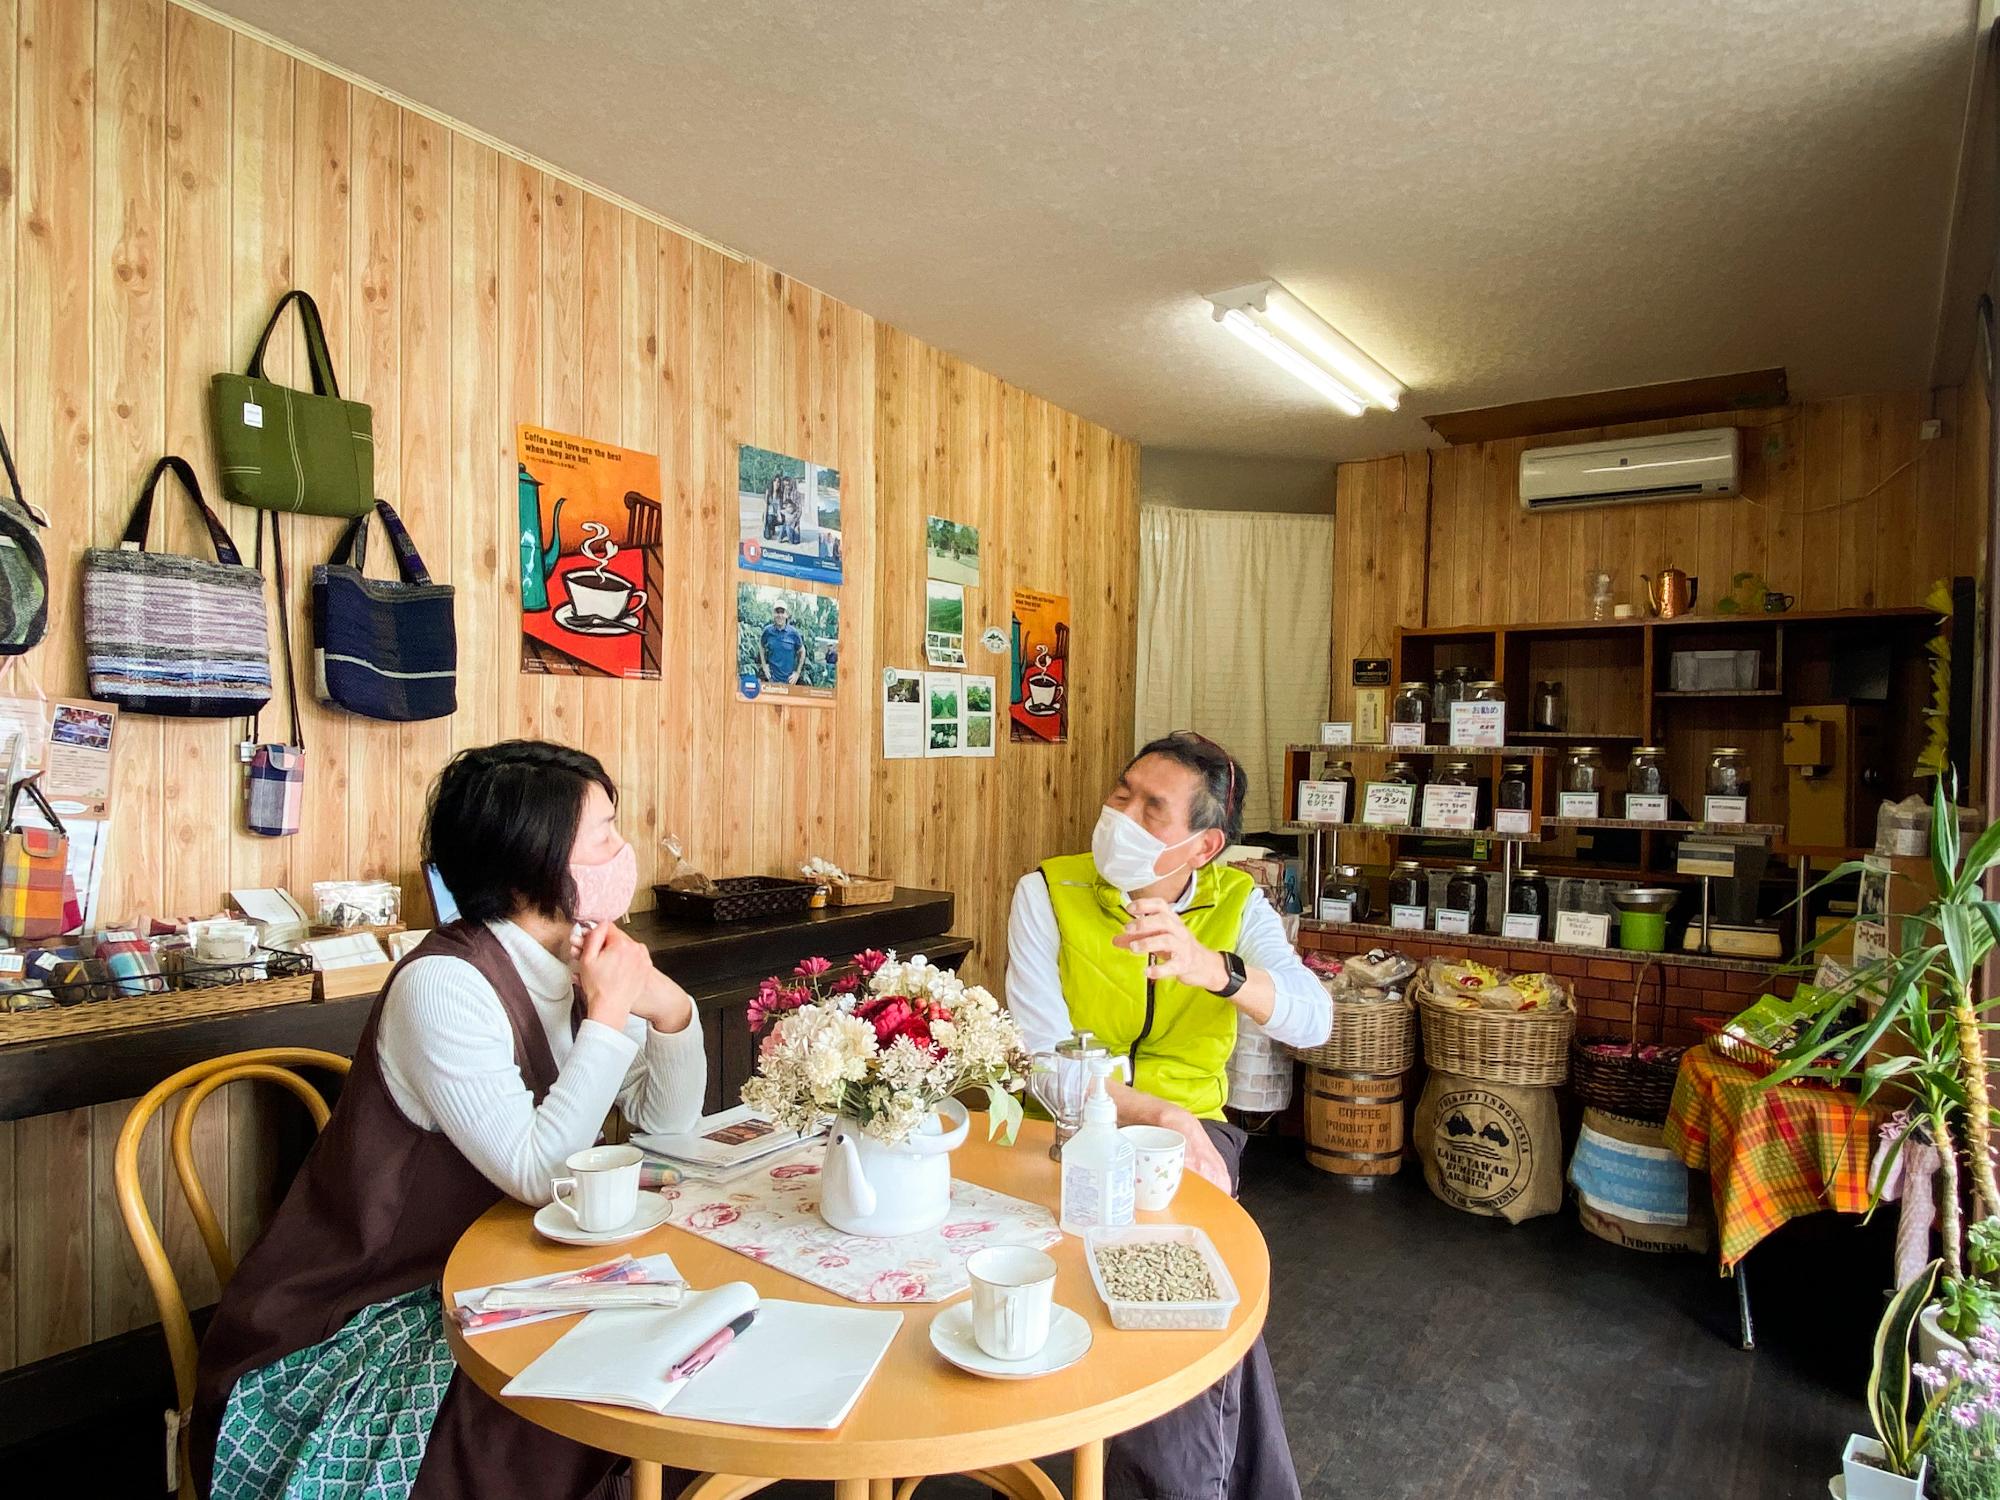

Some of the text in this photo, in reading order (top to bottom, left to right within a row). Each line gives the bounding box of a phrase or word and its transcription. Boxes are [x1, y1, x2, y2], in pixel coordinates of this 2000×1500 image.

[523, 431, 622, 462] Coffee and love are the best
[525, 443, 545, 455] when
[546, 448, 562, 460] they
[564, 452, 576, 461] are
[1338, 1106, 1382, 1120] COFFEE
[1325, 1119, 1392, 1135] PRODUCT OF
[1324, 1134, 1370, 1150] JAMAICA
[1437, 1147, 1510, 1178] LAKE TAWAR
[1621, 1234, 1689, 1253] INDONESIA
